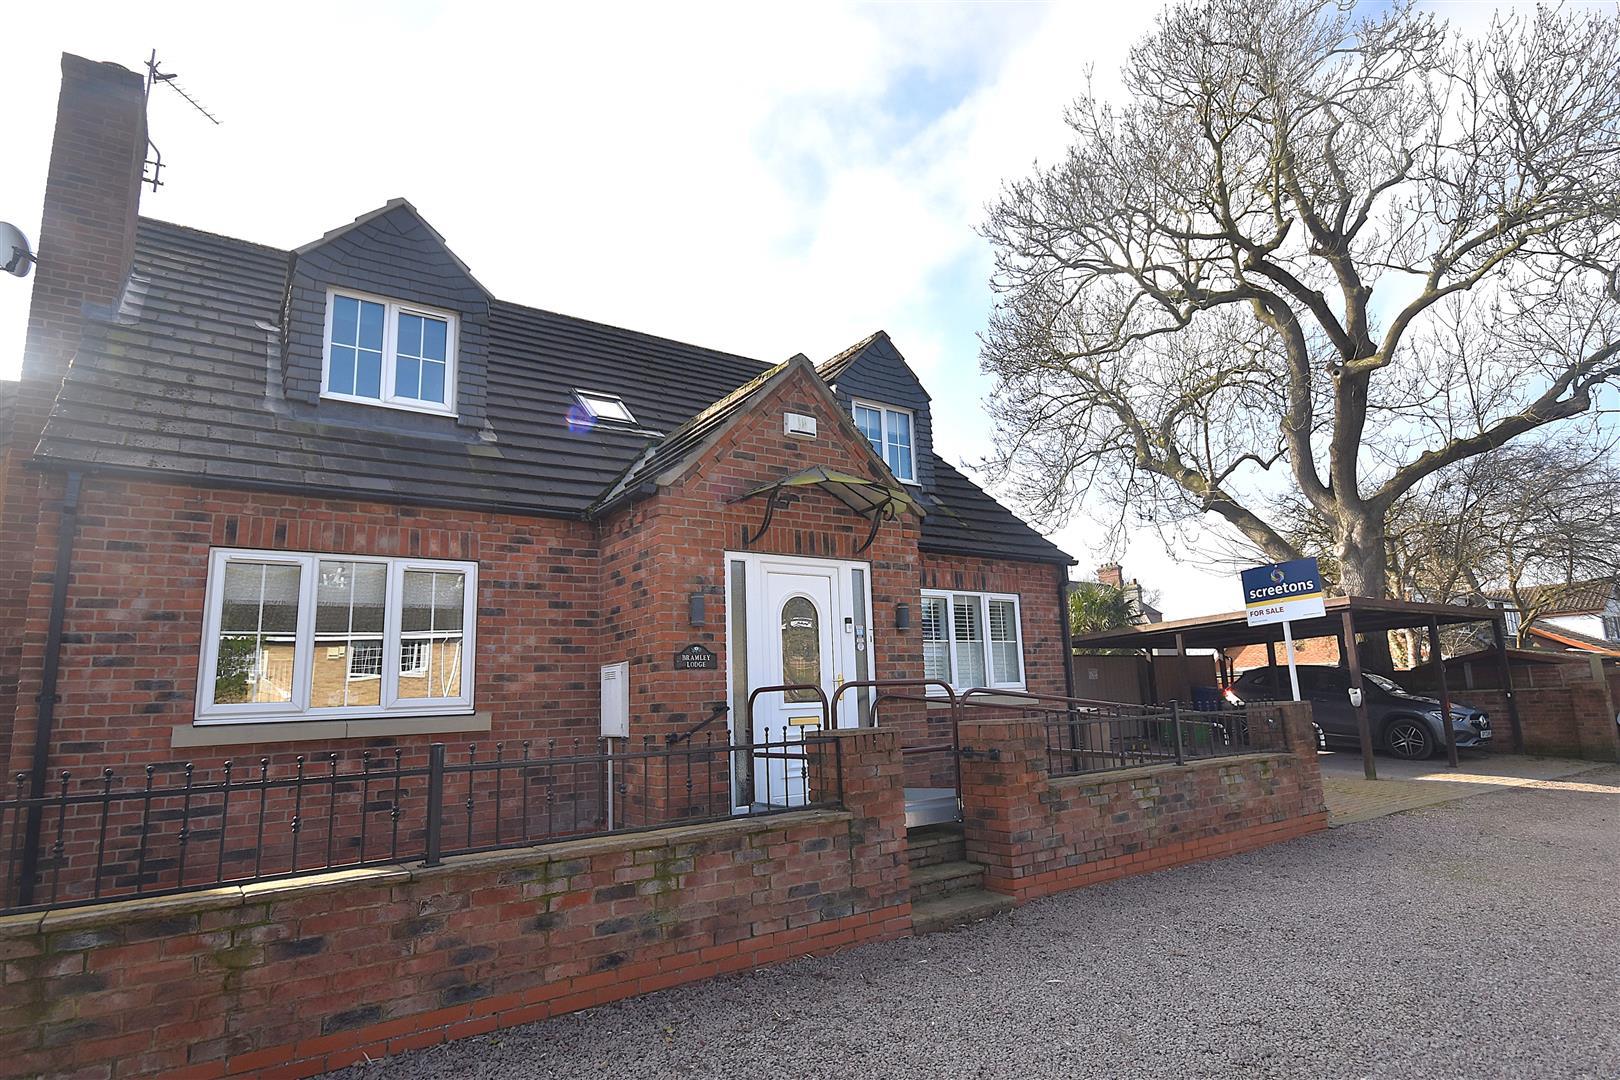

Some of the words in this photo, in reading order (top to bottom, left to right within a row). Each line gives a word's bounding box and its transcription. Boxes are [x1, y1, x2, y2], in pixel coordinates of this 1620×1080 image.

[1249, 580, 1314, 599] screetons
[1249, 609, 1265, 617] FOR
[1265, 606, 1285, 615] SALE
